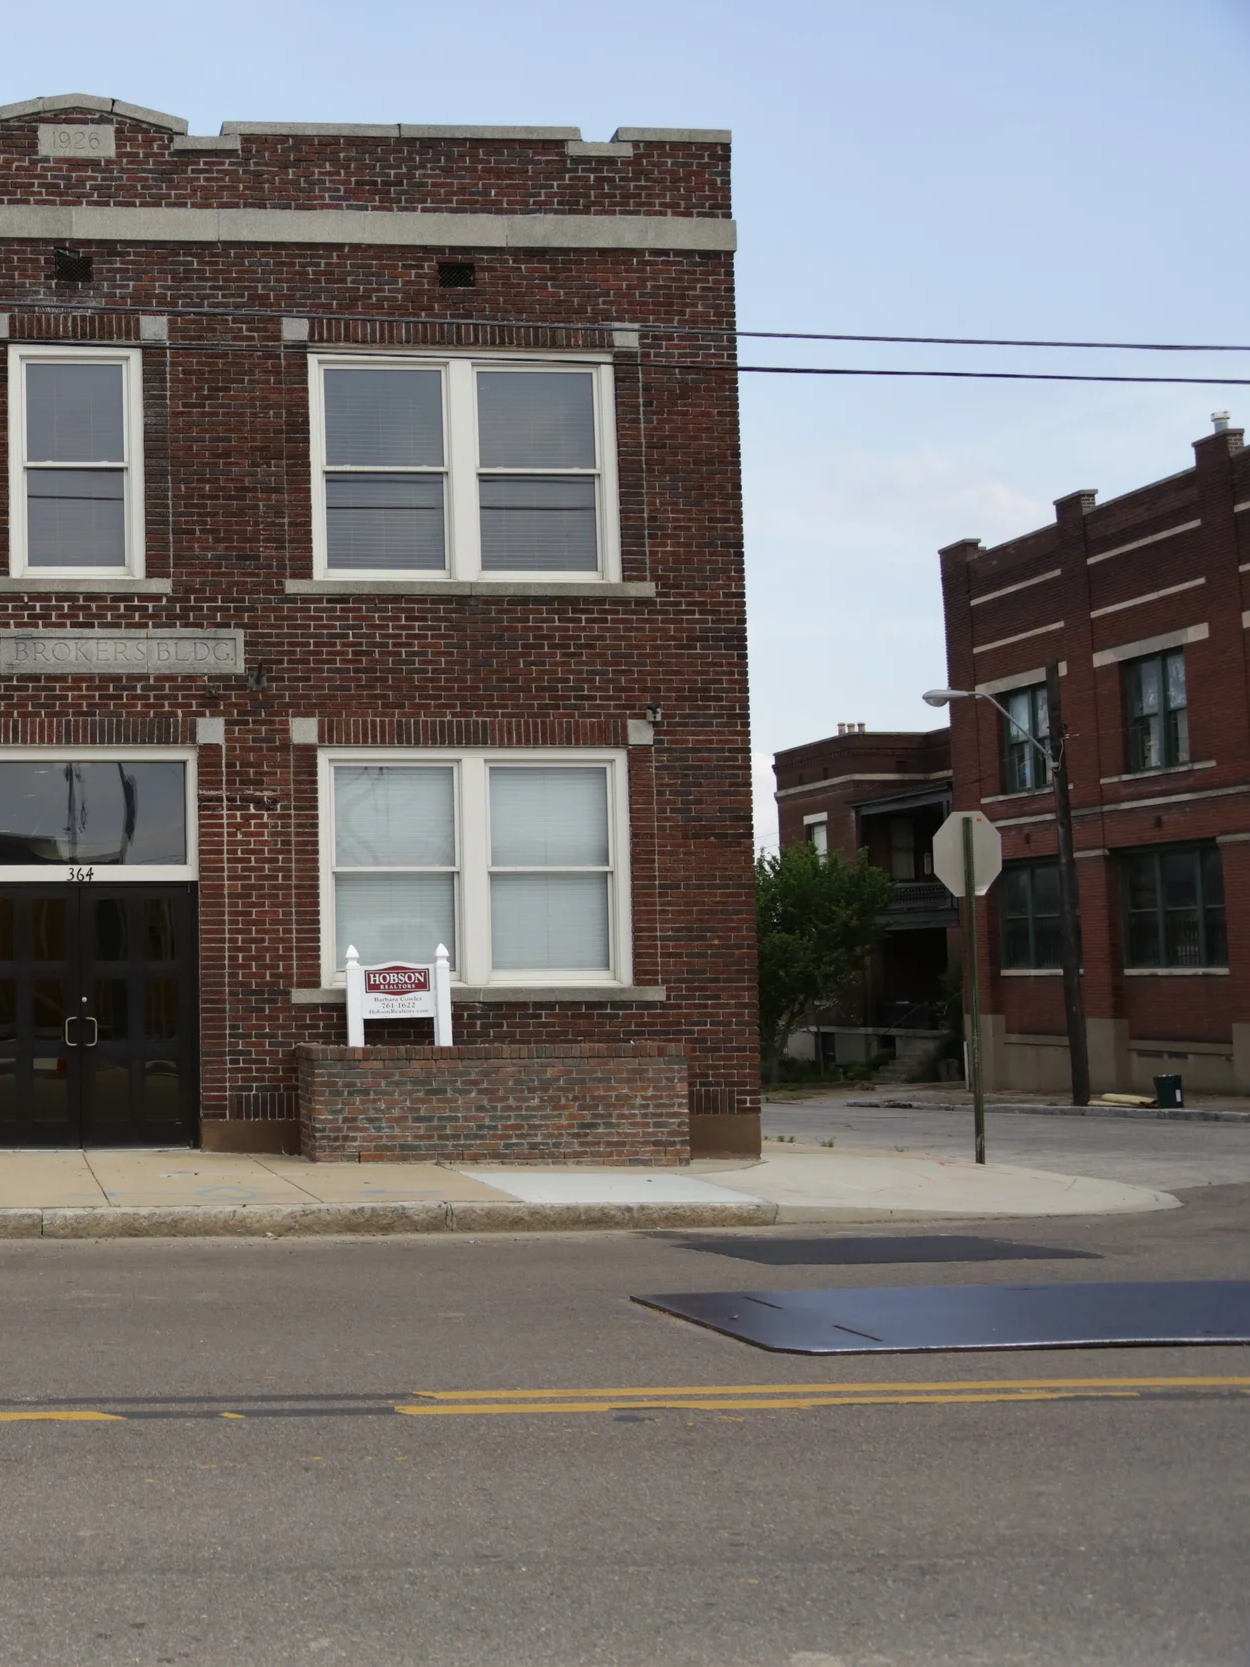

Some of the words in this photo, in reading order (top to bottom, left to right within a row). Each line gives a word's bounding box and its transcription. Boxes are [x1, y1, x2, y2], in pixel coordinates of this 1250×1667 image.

[52, 131, 100, 150] 1926
[14, 641, 146, 662] BROKERS
[156, 641, 234, 662] BLDG.
[66, 867, 94, 881] 364
[369, 972, 425, 984] HOBSON
